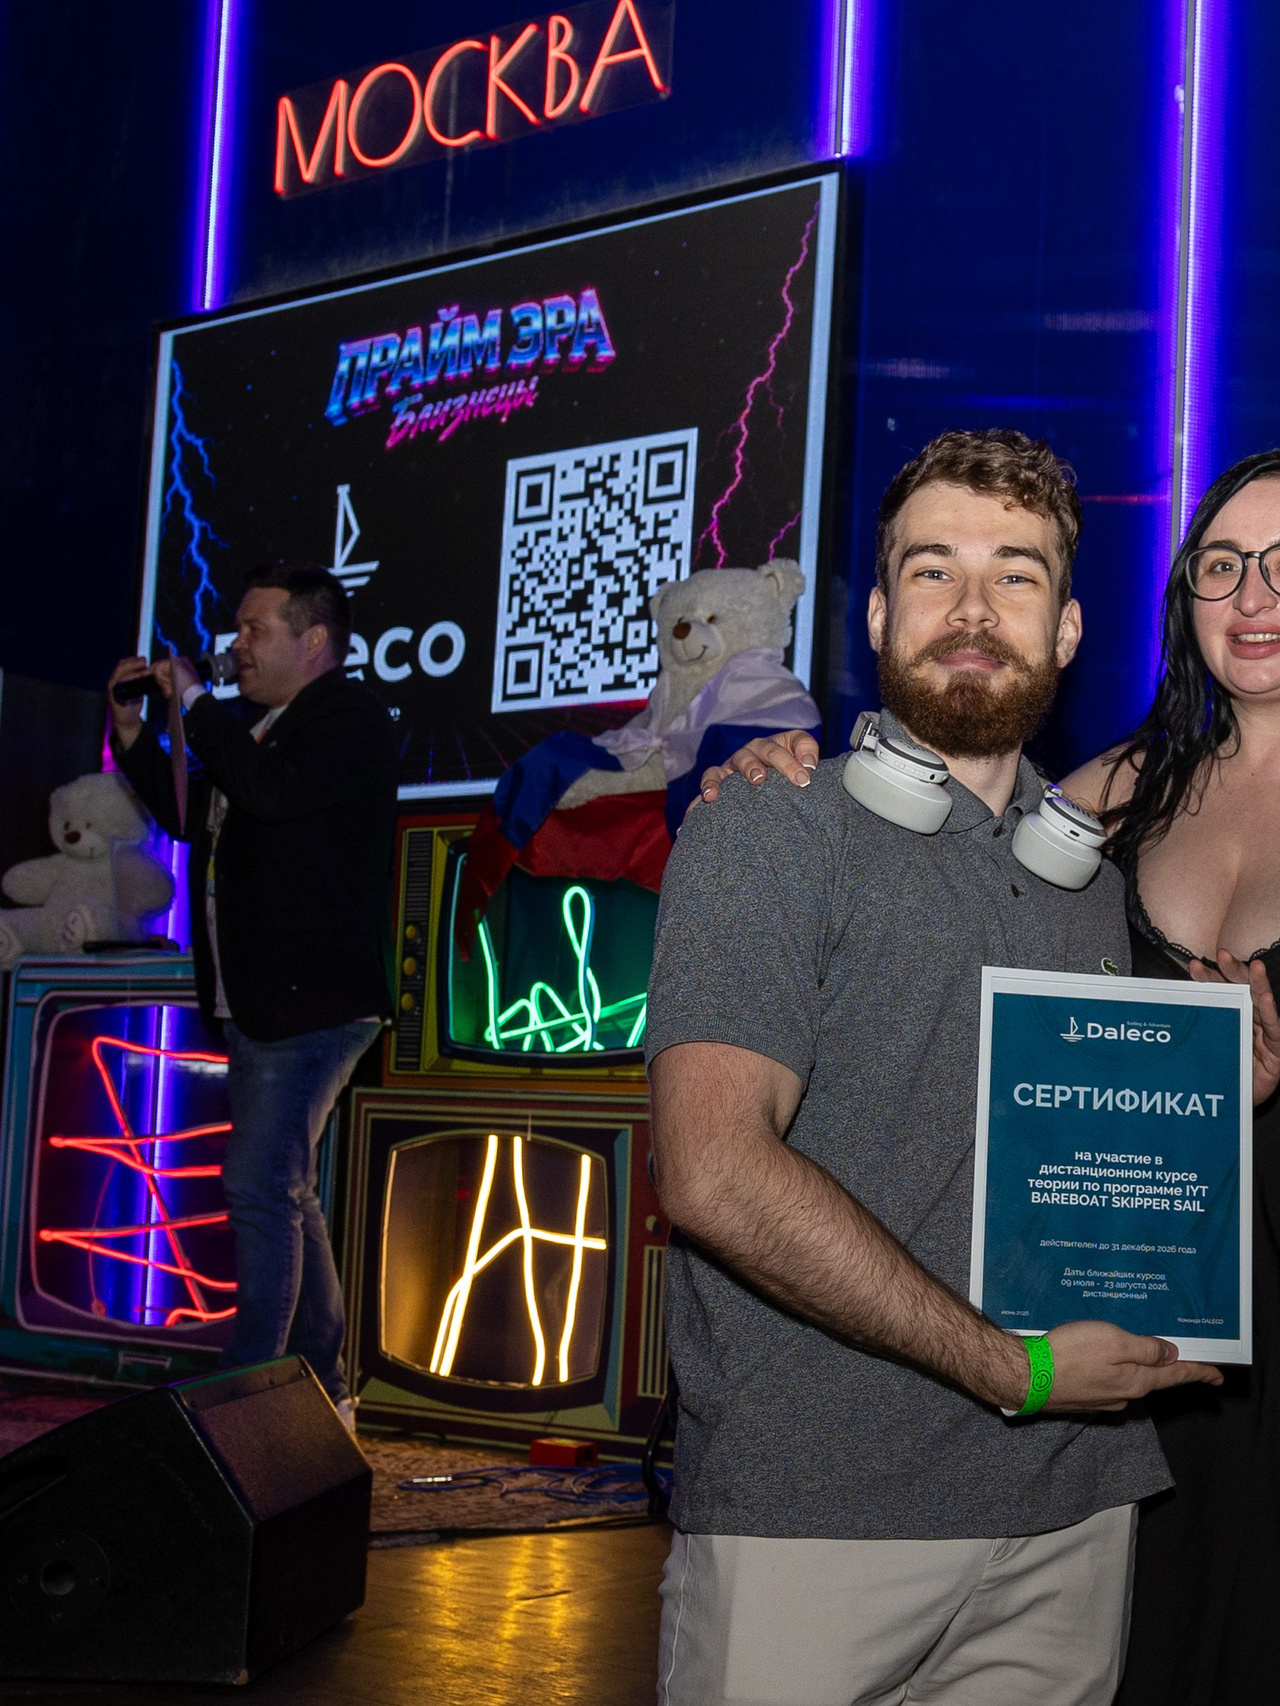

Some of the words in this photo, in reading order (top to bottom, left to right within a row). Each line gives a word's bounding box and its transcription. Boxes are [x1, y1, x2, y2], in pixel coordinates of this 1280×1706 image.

[274, 0, 668, 195] МОСКВА
[324, 304, 503, 426] ПРАЙМ
[506, 286, 616, 372] ЭРА
[386, 376, 540, 448] Близнецы
[1087, 1022, 1171, 1043] Daleco
[1013, 1082, 1225, 1117] СЕРТИФИКАТ
[1075, 1151, 1092, 1161] на
[1095, 1152, 1151, 1165] участие
[1155, 1156, 1163, 1165] в
[1039, 1164, 1152, 1179] дистанционном
[1155, 1171, 1198, 1184] курсе
[1028, 1178, 1080, 1191] теории
[1083, 1182, 1100, 1192] по
[1103, 1183, 1183, 1196] программе
[1186, 1185, 1208, 1197] IYT
[1031, 1192, 1108, 1207] BAREBOAT
[1111, 1196, 1170, 1210] SKIPPER
[1173, 1200, 1206, 1212] SAIL
[1039, 1239, 1097, 1249] действителен
[1111, 1243, 1120, 1251] 31
[1121, 1243, 1156, 1253] декабря
[1157, 1245, 1177, 1253] 2026
[1178, 1246, 1197, 1254] года
[1063, 1267, 1085, 1277] Даты
[1086, 1268, 1135, 1279] ближайших
[1060, 1279, 1072, 1287] 09
[1073, 1279, 1095, 1287] июля
[1104, 1281, 1114, 1289] 23
[1115, 1281, 1147, 1291] августа
[1082, 1290, 1148, 1300] дистанционный
